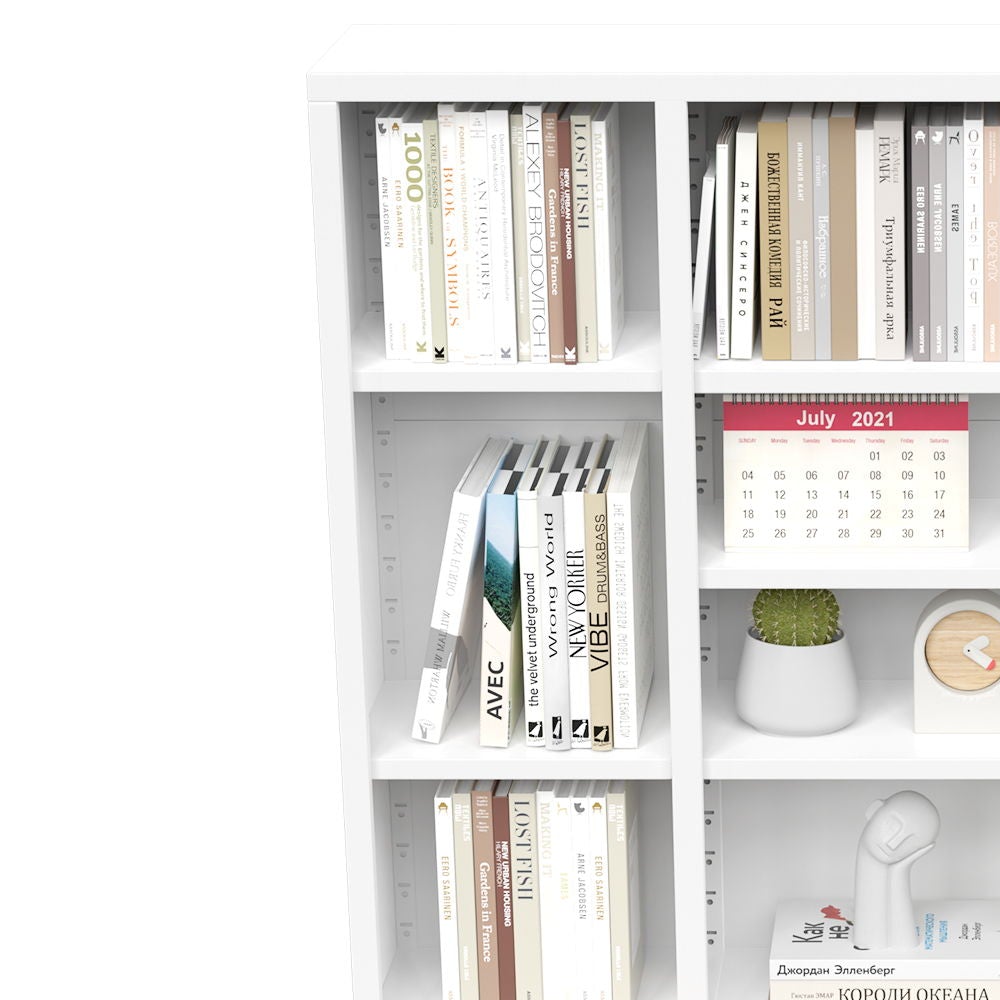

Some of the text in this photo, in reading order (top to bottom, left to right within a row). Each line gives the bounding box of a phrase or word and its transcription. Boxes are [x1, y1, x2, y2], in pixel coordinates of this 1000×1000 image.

[404, 132, 423, 202] 1000
[574, 124, 588, 177] LOST
[477, 180, 490, 299] ANTIQUAIRES
[525, 113, 546, 346] ALEXEY BRODOVITCH
[549, 188, 559, 296] Gardens in France
[739, 182, 749, 316] ДЖЕН СИНСЕРО
[767, 152, 787, 328] БОЖЕСТВЕННАЯ КОМЕДИЯ РАЙ
[882, 217, 896, 340] Триумфальная арка
[796, 410, 894, 429] July 2021
[870, 451, 945, 460] 01 02 03
[742, 471, 946, 480] 04 05 06 07 08 09 10
[742, 509, 946, 519] 18 19 20 21 22 23 24
[544, 513, 558, 658] Wrong World
[566, 549, 587, 658] NEW YORKER
[590, 514, 609, 672] VIBE DRUM&BASS
[487, 661, 504, 720] AVEC
[524, 572, 539, 706] the velvet underground
[515, 801, 533, 900] LOST FISH
[777, 964, 896, 977] Джордан Элленберг
[792, 922, 850, 943] Как не
